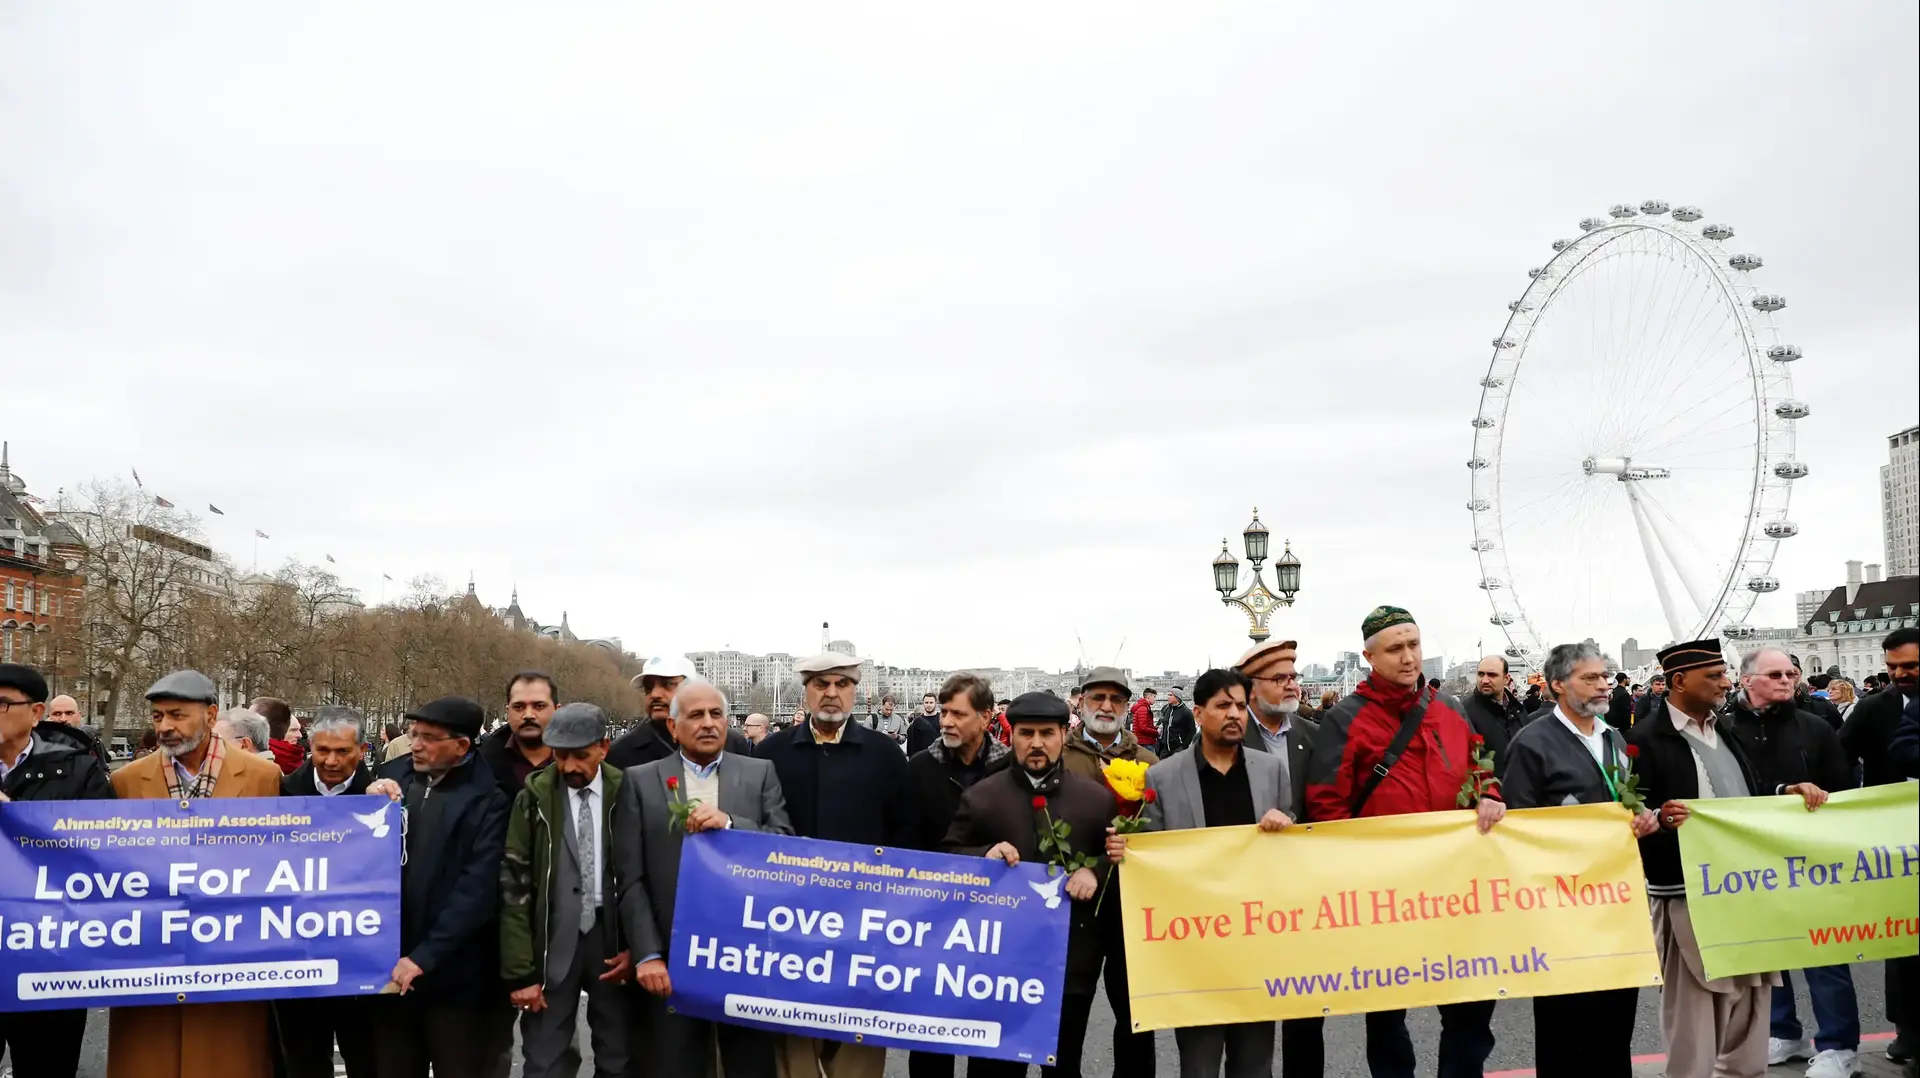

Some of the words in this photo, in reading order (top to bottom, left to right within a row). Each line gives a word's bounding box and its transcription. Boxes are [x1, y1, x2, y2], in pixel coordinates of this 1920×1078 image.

[14, 836, 100, 850] “Promoting
[107, 834, 155, 847] Peace
[160, 833, 190, 846] and
[196, 831, 266, 847] Harmony
[271, 830, 285, 843] in
[289, 828, 352, 844] Society”
[53, 816, 153, 832] Ahmadiyya
[157, 815, 214, 828] Muslim
[218, 813, 311, 827] Association
[35, 866, 150, 900] Love
[169, 862, 250, 897] For
[265, 858, 328, 893] All
[726, 864, 806, 887] “Promoting
[810, 874, 852, 890] Peace
[855, 878, 882, 893] and
[886, 882, 948, 902] Harmony
[953, 889, 965, 901] in
[969, 891, 1027, 909] Society”
[766, 851, 850, 873] Ahmadiyya
[853, 861, 904, 878] Muslim
[907, 866, 991, 887] Association
[1699, 863, 1778, 896] Love
[1784, 856, 1843, 889] For
[1850, 845, 1895, 883] All
[0, 910, 141, 951] atred
[161, 910, 243, 944] For
[260, 905, 381, 942] None
[742, 896, 844, 938] Love
[859, 908, 932, 947] For
[944, 918, 1002, 955] All
[1141, 906, 1231, 943] Love
[1241, 900, 1304, 937] For
[1314, 890, 1362, 931] All
[1368, 878, 1481, 925] Hatred
[1487, 877, 1550, 913] For
[1552, 873, 1631, 909] None
[31, 966, 324, 993] www.ukmuslimsforpeace.com
[687, 935, 834, 984] Hatred
[848, 954, 921, 993] For
[935, 964, 1045, 1005] None
[1263, 946, 1551, 999] www.true-islam.uk
[736, 1002, 986, 1040] www.ukmuslimsforpeace.com
